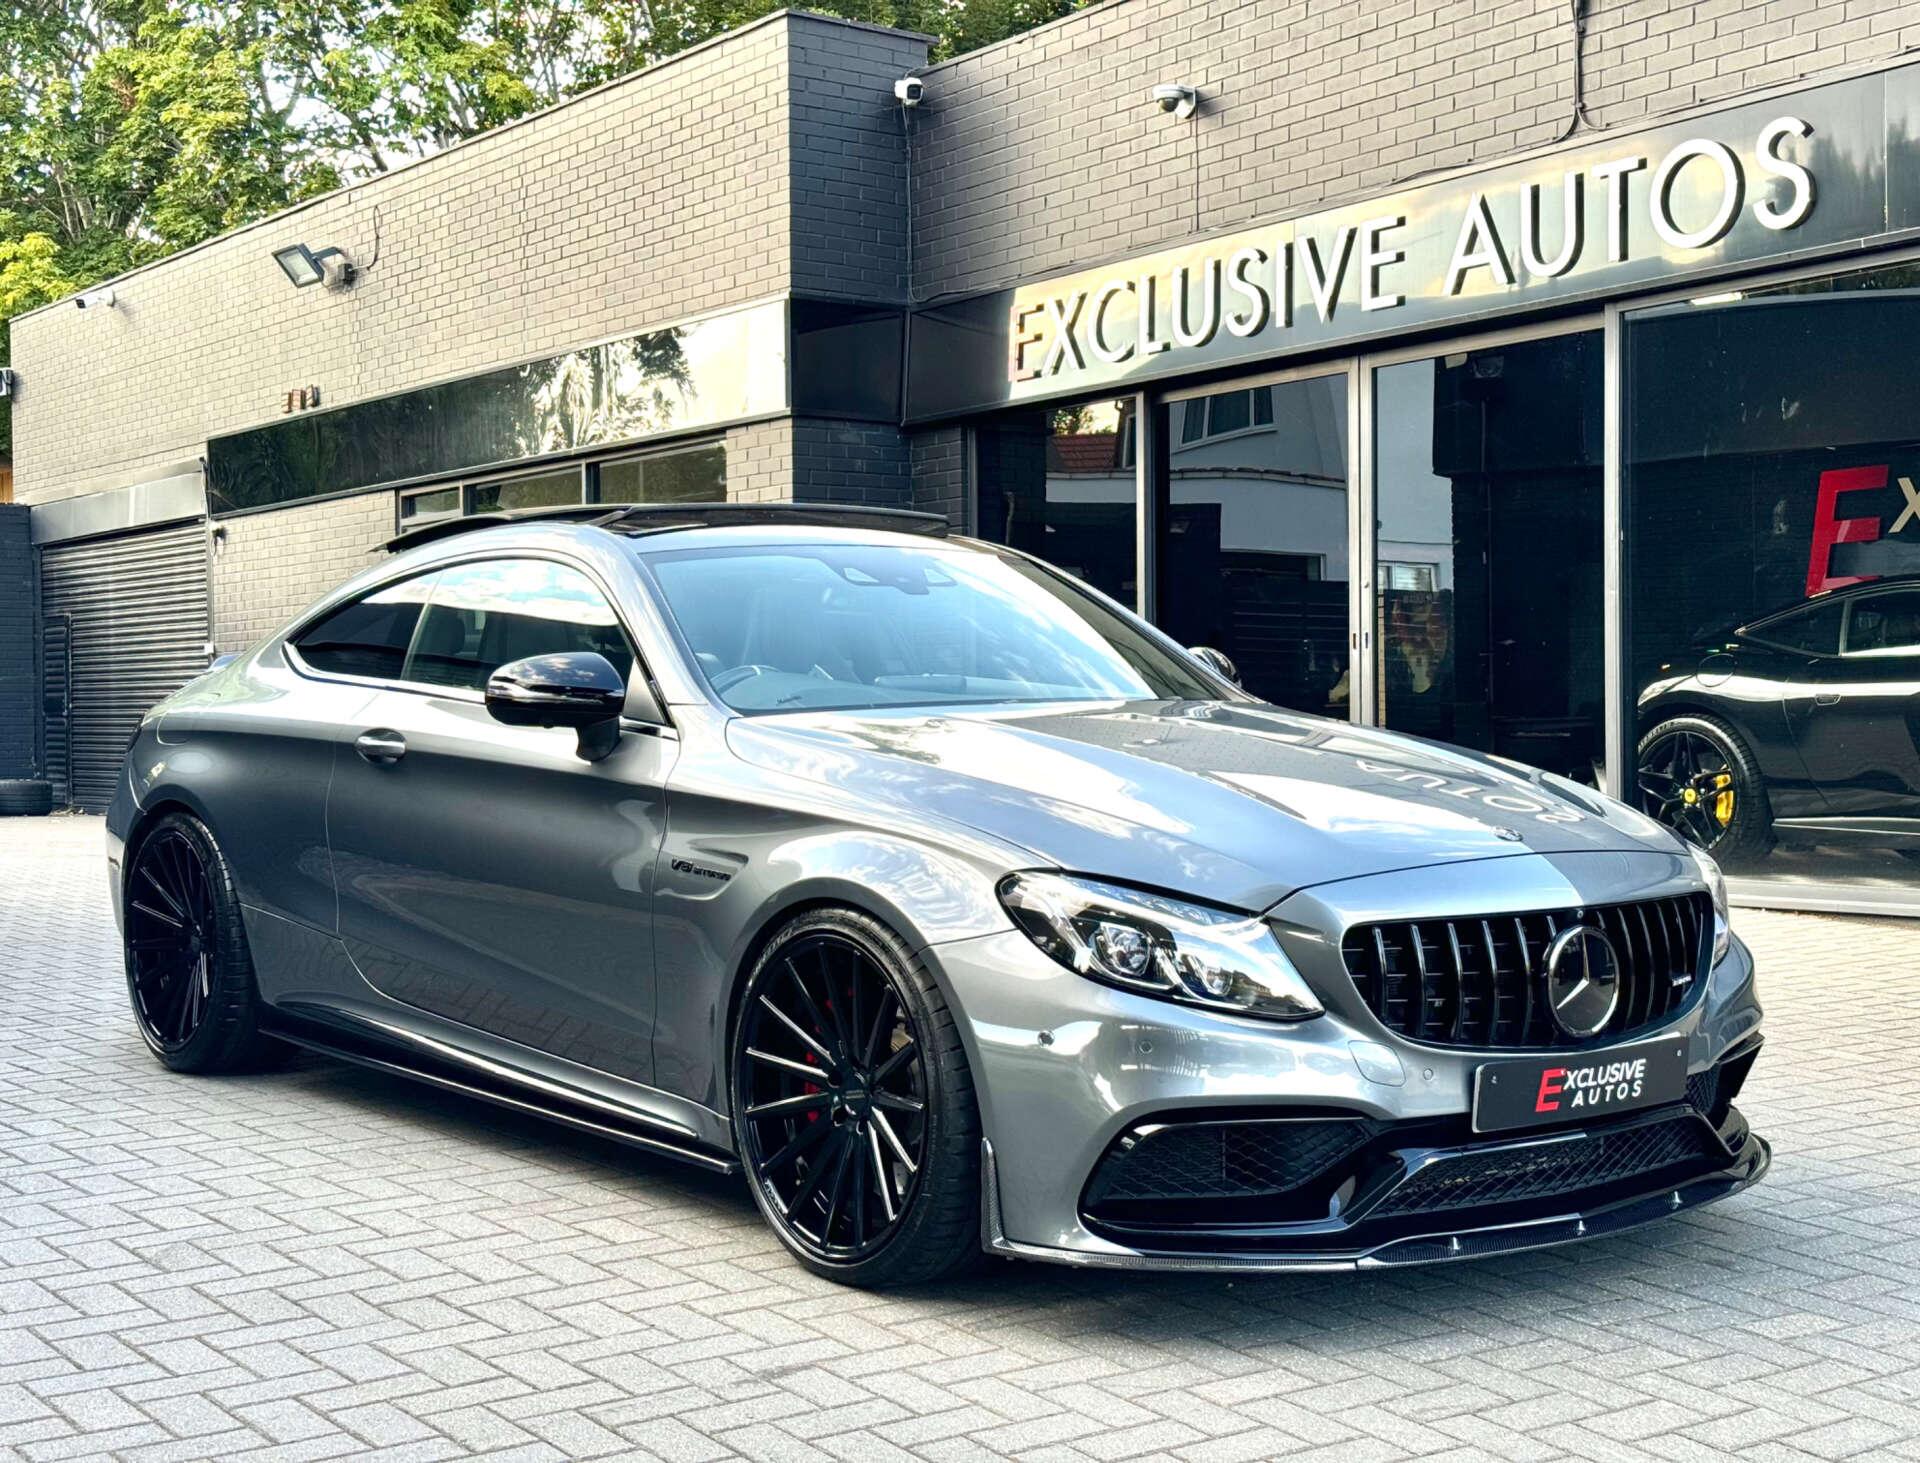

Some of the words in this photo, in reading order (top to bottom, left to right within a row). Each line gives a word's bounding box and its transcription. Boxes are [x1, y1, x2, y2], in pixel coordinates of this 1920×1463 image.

[1008, 215, 1406, 382] EXCLUSIVE
[1441, 116, 1818, 297] AUTOS
[1535, 1058, 1646, 1112] EXCLUSIVE
[1571, 1080, 1642, 1107] AUTOS
